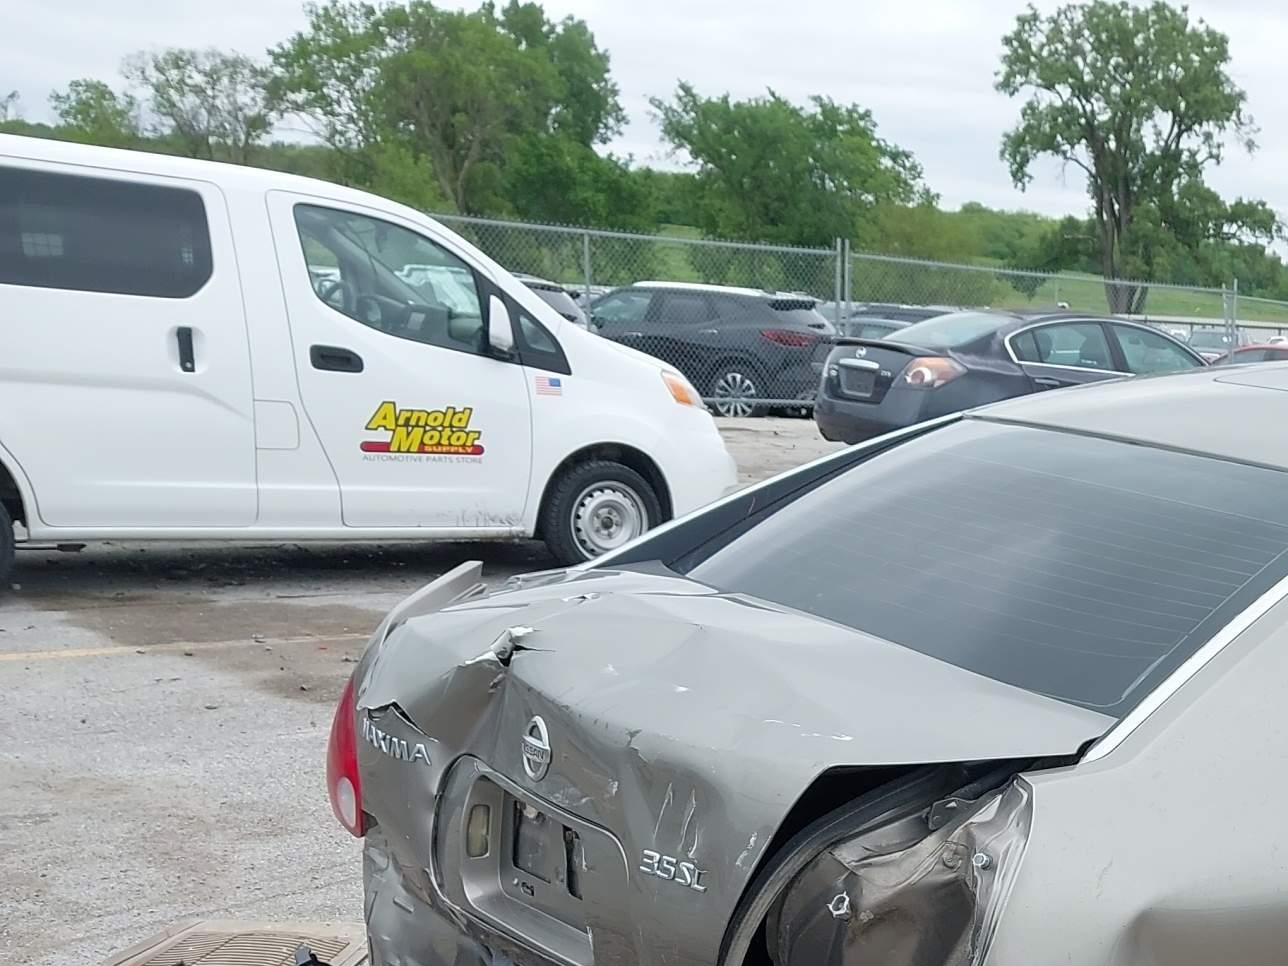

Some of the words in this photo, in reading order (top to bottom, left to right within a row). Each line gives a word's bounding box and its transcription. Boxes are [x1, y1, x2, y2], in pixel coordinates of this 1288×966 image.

[365, 400, 473, 430] Arnold
[389, 426, 481, 453] Motor
[423, 445, 474, 453] SUPPLY
[362, 455, 422, 463] AUTOMOTIVE
[426, 456, 454, 464] PARTS
[456, 456, 483, 465] STORE
